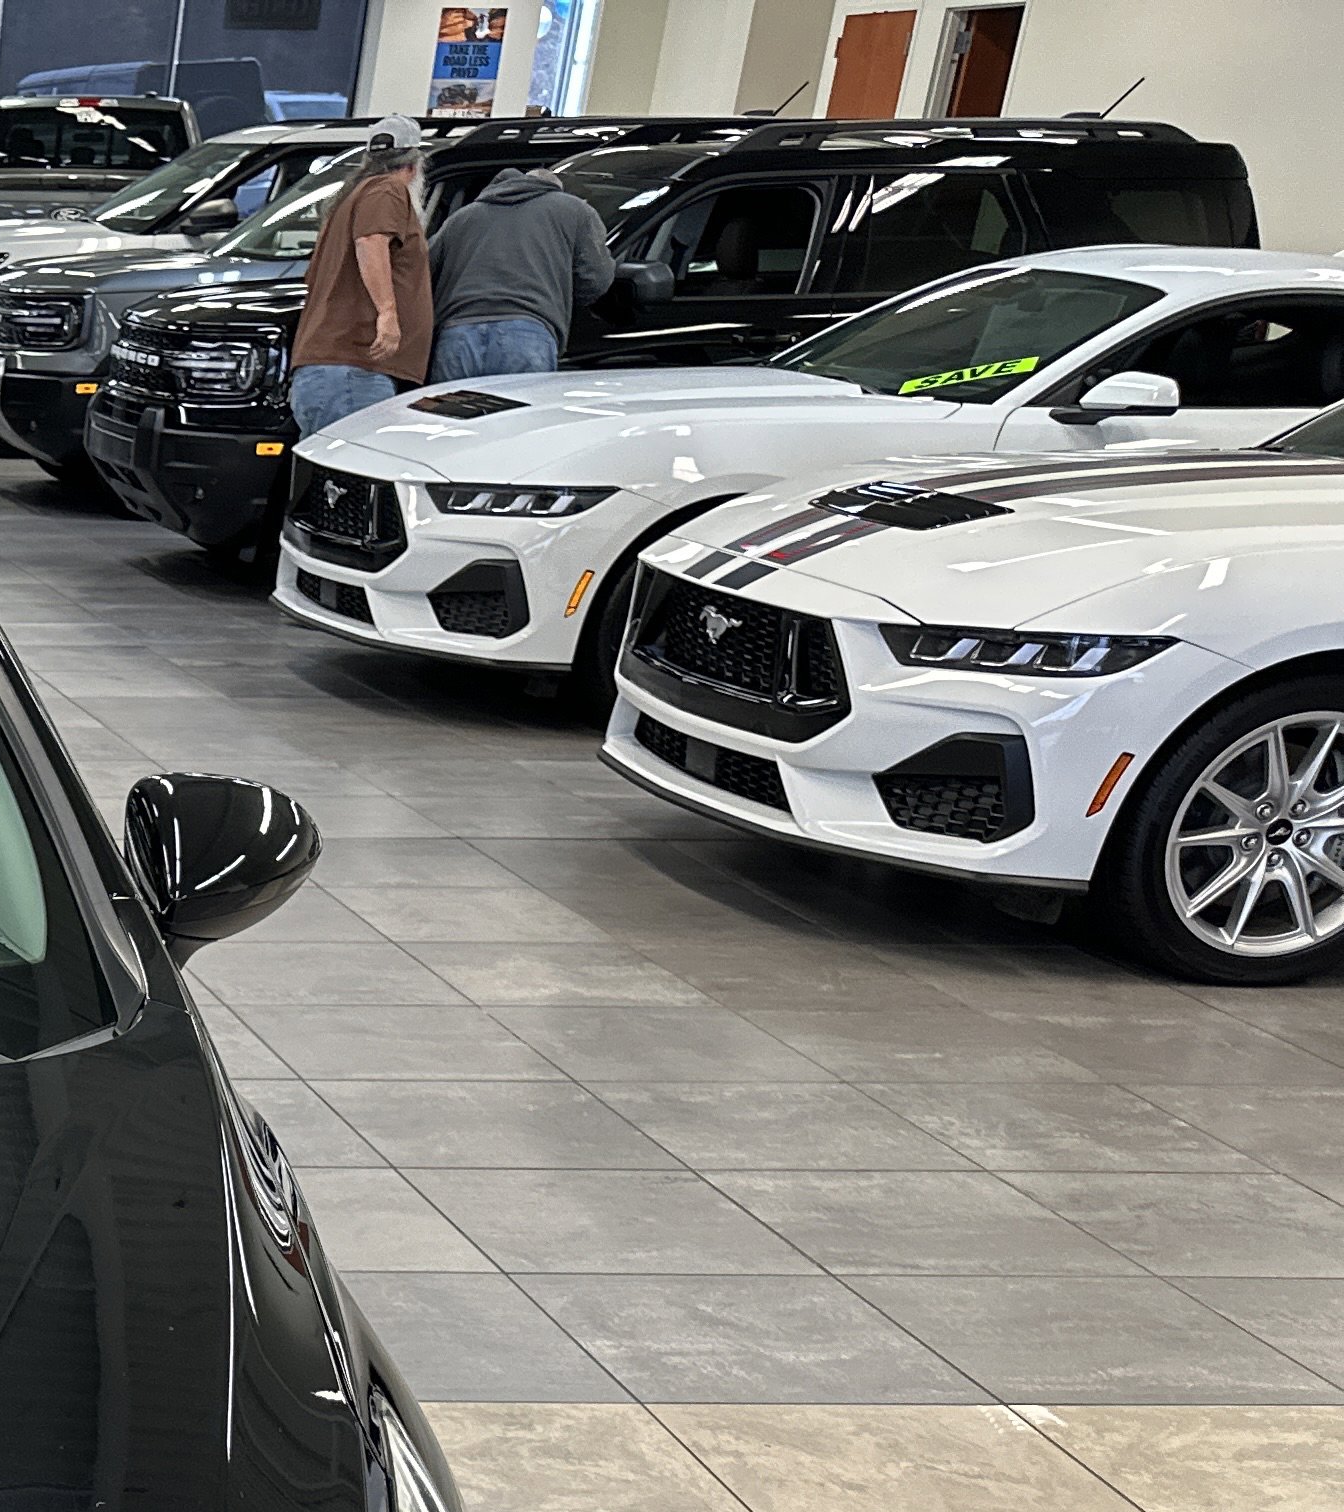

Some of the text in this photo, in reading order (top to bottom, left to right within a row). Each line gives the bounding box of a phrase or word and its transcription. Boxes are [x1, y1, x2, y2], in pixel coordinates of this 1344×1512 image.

[448, 44, 488, 55] TAKE THE
[443, 55, 490, 67] ROAD LESS
[450, 67, 479, 78] PAVED
[914, 359, 1021, 389] SAVE
